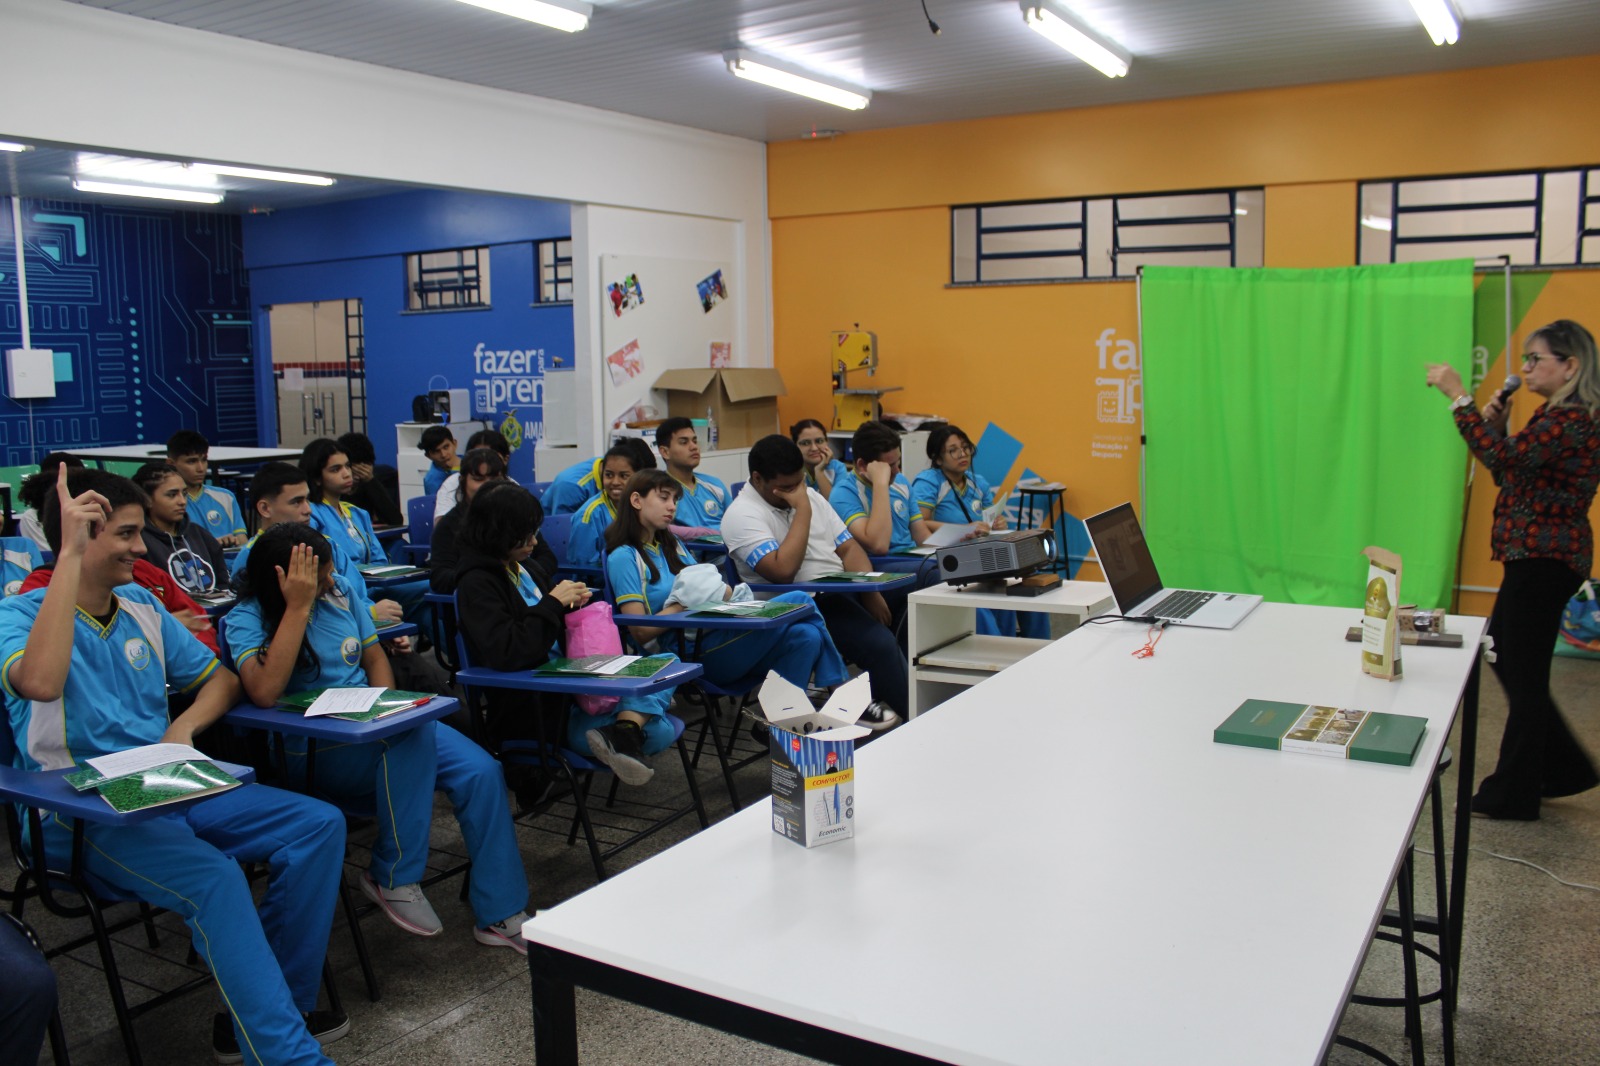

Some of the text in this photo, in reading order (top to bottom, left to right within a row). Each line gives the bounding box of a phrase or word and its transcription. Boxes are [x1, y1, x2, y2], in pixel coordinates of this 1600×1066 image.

[474, 343, 536, 374] fazer
[1095, 328, 1140, 370] fa
[812, 773, 850, 787] COMPACTOR
[819, 826, 846, 837] Economic
